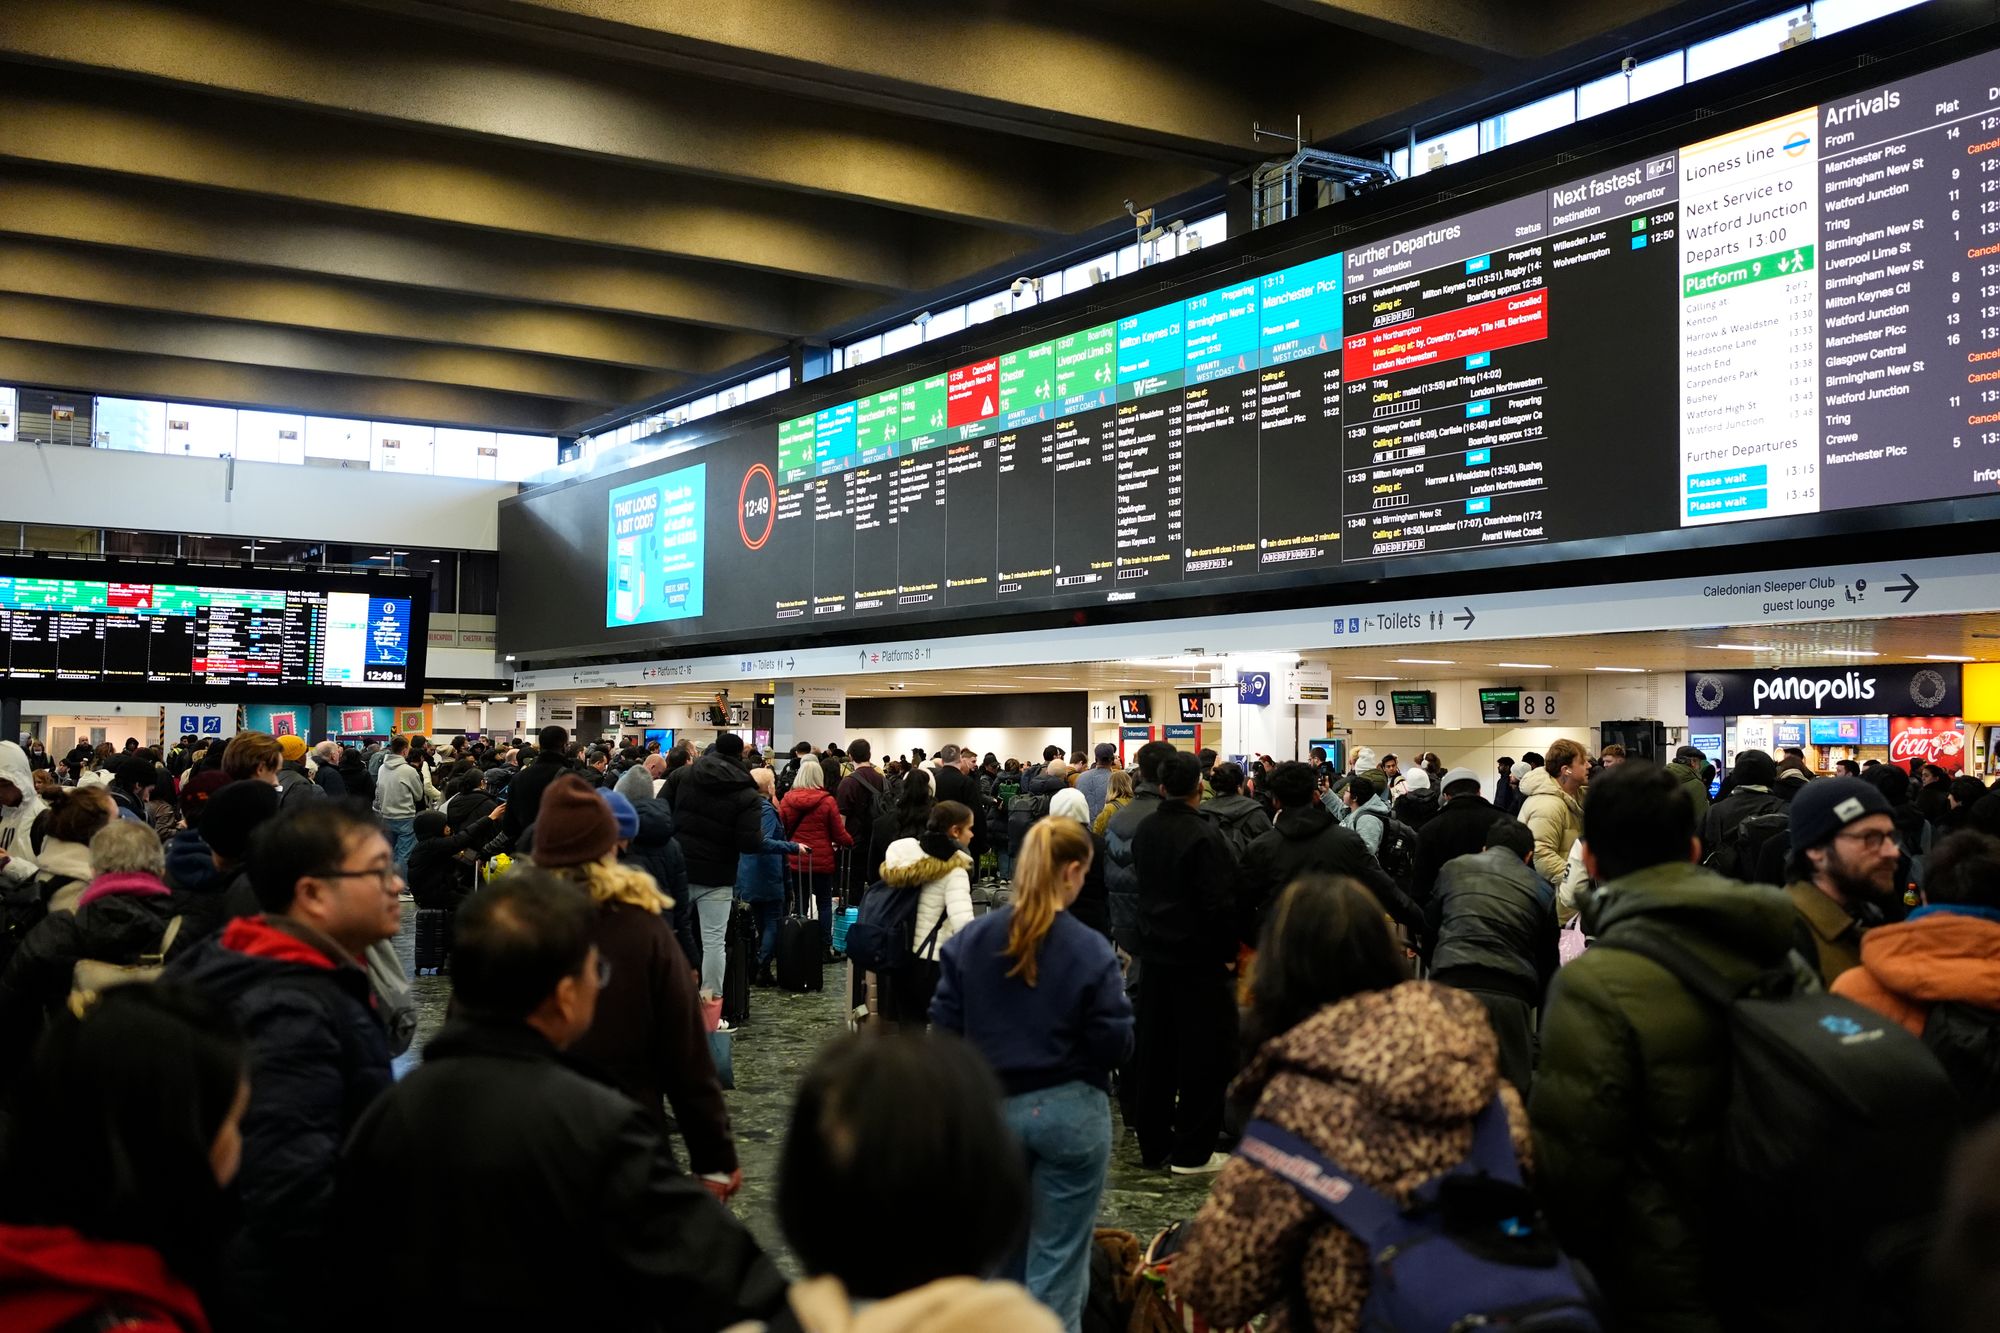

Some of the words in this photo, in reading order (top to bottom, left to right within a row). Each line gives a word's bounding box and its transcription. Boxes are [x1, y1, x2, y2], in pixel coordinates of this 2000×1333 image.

[1824, 90, 1900, 128] Arrivals
[1825, 132, 1854, 148] From
[1936, 100, 1959, 116] Plat
[1825, 150, 1883, 174] Manchester
[1885, 144, 1906, 158] Picc
[1947, 127, 1960, 140] 14
[1656, 162, 1665, 172] of
[1686, 157, 1740, 182] Lioness
[1746, 147, 1774, 164] line
[1825, 171, 1884, 194] Birmingham
[1887, 162, 1910, 177] New
[1912, 158, 1924, 170] St
[1553, 185, 1587, 209] Next
[1589, 168, 1641, 198] fastest
[1686, 200, 1718, 218] Next
[1723, 186, 1773, 208] Service
[1778, 180, 1793, 193] to
[1825, 194, 1864, 213] Watford
[1867, 183, 1909, 202] Junction
[1952, 168, 1960, 180] 9
[1553, 206, 1600, 227] Destination
[1625, 187, 1666, 206] Operator
[1825, 218, 1850, 232] Tring
[1949, 189, 1960, 201] 11
[1553, 236, 1588, 252] Willesden
[1589, 231, 1607, 244] Junc
[1650, 212, 1674, 226] 13:00
[1686, 216, 1742, 241] Watford
[1746, 201, 1808, 226] Junction
[1825, 229, 1884, 252] Birmingham
[1887, 224, 1910, 238] New
[1912, 219, 1924, 231] St
[1952, 210, 1960, 221] 6
[1348, 245, 1391, 269] Further
[1393, 225, 1460, 256] Departures
[1348, 273, 1364, 285] Time
[1373, 260, 1412, 278] Destination
[1515, 222, 1542, 237] Status
[1553, 247, 1611, 269] Wolverhampton
[1650, 229, 1674, 243] 12:50
[1687, 242, 1739, 264] Departs
[1749, 228, 1787, 248] 13:00
[1825, 251, 1870, 270] Liverpool
[1873, 246, 1898, 260] Lime
[1900, 242, 1911, 254] St
[1263, 274, 1284, 289] 13:13
[1373, 280, 1420, 299] Wolverhampton
[1508, 246, 1542, 262] Preparing
[1686, 269, 1747, 293] Platform
[1752, 262, 1762, 276] 9
[1825, 268, 1884, 290] Birmingham
[1887, 264, 1910, 278] New
[1912, 259, 1924, 271] St
[1263, 285, 1315, 309] Manchester
[1317, 280, 1336, 294] Picc
[1466, 288, 1496, 303] Boarding
[1497, 283, 1521, 296] approx
[1522, 276, 1542, 289] 12:58
[1825, 293, 1856, 309] Milton
[1858, 287, 1894, 302] Keynes
[1896, 282, 1911, 294] Ctl
[1952, 272, 1960, 283] 8
[1825, 311, 1866, 329] Watford
[1867, 303, 1910, 321] Junction
[1952, 292, 1960, 304] 9
[1825, 329, 1883, 348] Manchester
[1885, 324, 1907, 337] Picc
[1947, 313, 1960, 326] 13
[1273, 340, 1298, 354] AVANTI
[1273, 352, 1291, 364] WEST
[1292, 346, 1315, 359] COAST
[1686, 343, 1733, 358] Headstone
[1736, 338, 1757, 349] Lane
[1825, 350, 1868, 368] Glasgow
[1870, 344, 1907, 359] Central
[1947, 334, 1960, 346] 16
[1825, 366, 1884, 388] Birmingham
[1887, 365, 1911, 378] New
[1912, 361, 1925, 372] St
[1825, 390, 1866, 406] Watford
[1867, 384, 1910, 400] Junction
[1826, 414, 1851, 426] Tring
[1949, 396, 1960, 408] 11
[1687, 448, 1728, 462] Further
[1732, 439, 1798, 456] Departures
[1826, 432, 1858, 445] Crewe
[1826, 449, 1884, 465] Manchester
[1886, 445, 1907, 458] Picc
[1953, 437, 1961, 448] 5
[1470, 483, 1495, 495] London
[1690, 477, 1722, 489] Please
[1725, 473, 1747, 484] wait
[614, 500, 633, 518] THAT
[633, 493, 657, 513] LOOKS
[745, 496, 769, 518] 12:49
[616, 519, 623, 535] A
[634, 512, 654, 530] ODD?
[1703, 580, 1761, 598] Caledonian
[1764, 579, 1807, 596] Sleeper
[1809, 576, 1835, 590] Club
[1763, 601, 1794, 615] guest
[1796, 597, 1835, 612] lounge
[1377, 612, 1421, 630] Toilets
[758, 659, 775, 670] Toilets
[882, 649, 914, 662] Platforms
[367, 671, 394, 681] 12:49
[657, 666, 678, 677] Platforms
[1754, 671, 1876, 709] panopolis
[701, 712, 712, 722] 13
[738, 711, 749, 722] 12
[1092, 705, 1100, 719] 11
[1106, 705, 1116, 719] 11
[1204, 703, 1215, 718] 10
[1358, 699, 1366, 717] 9
[1376, 699, 1385, 717] 9
[1524, 696, 1535, 714] 8
[1545, 696, 1555, 714] 8
[1743, 737, 1767, 747] WHITE
[1746, 727, 1763, 737] FLAT
[1779, 727, 1799, 735] SWEET
